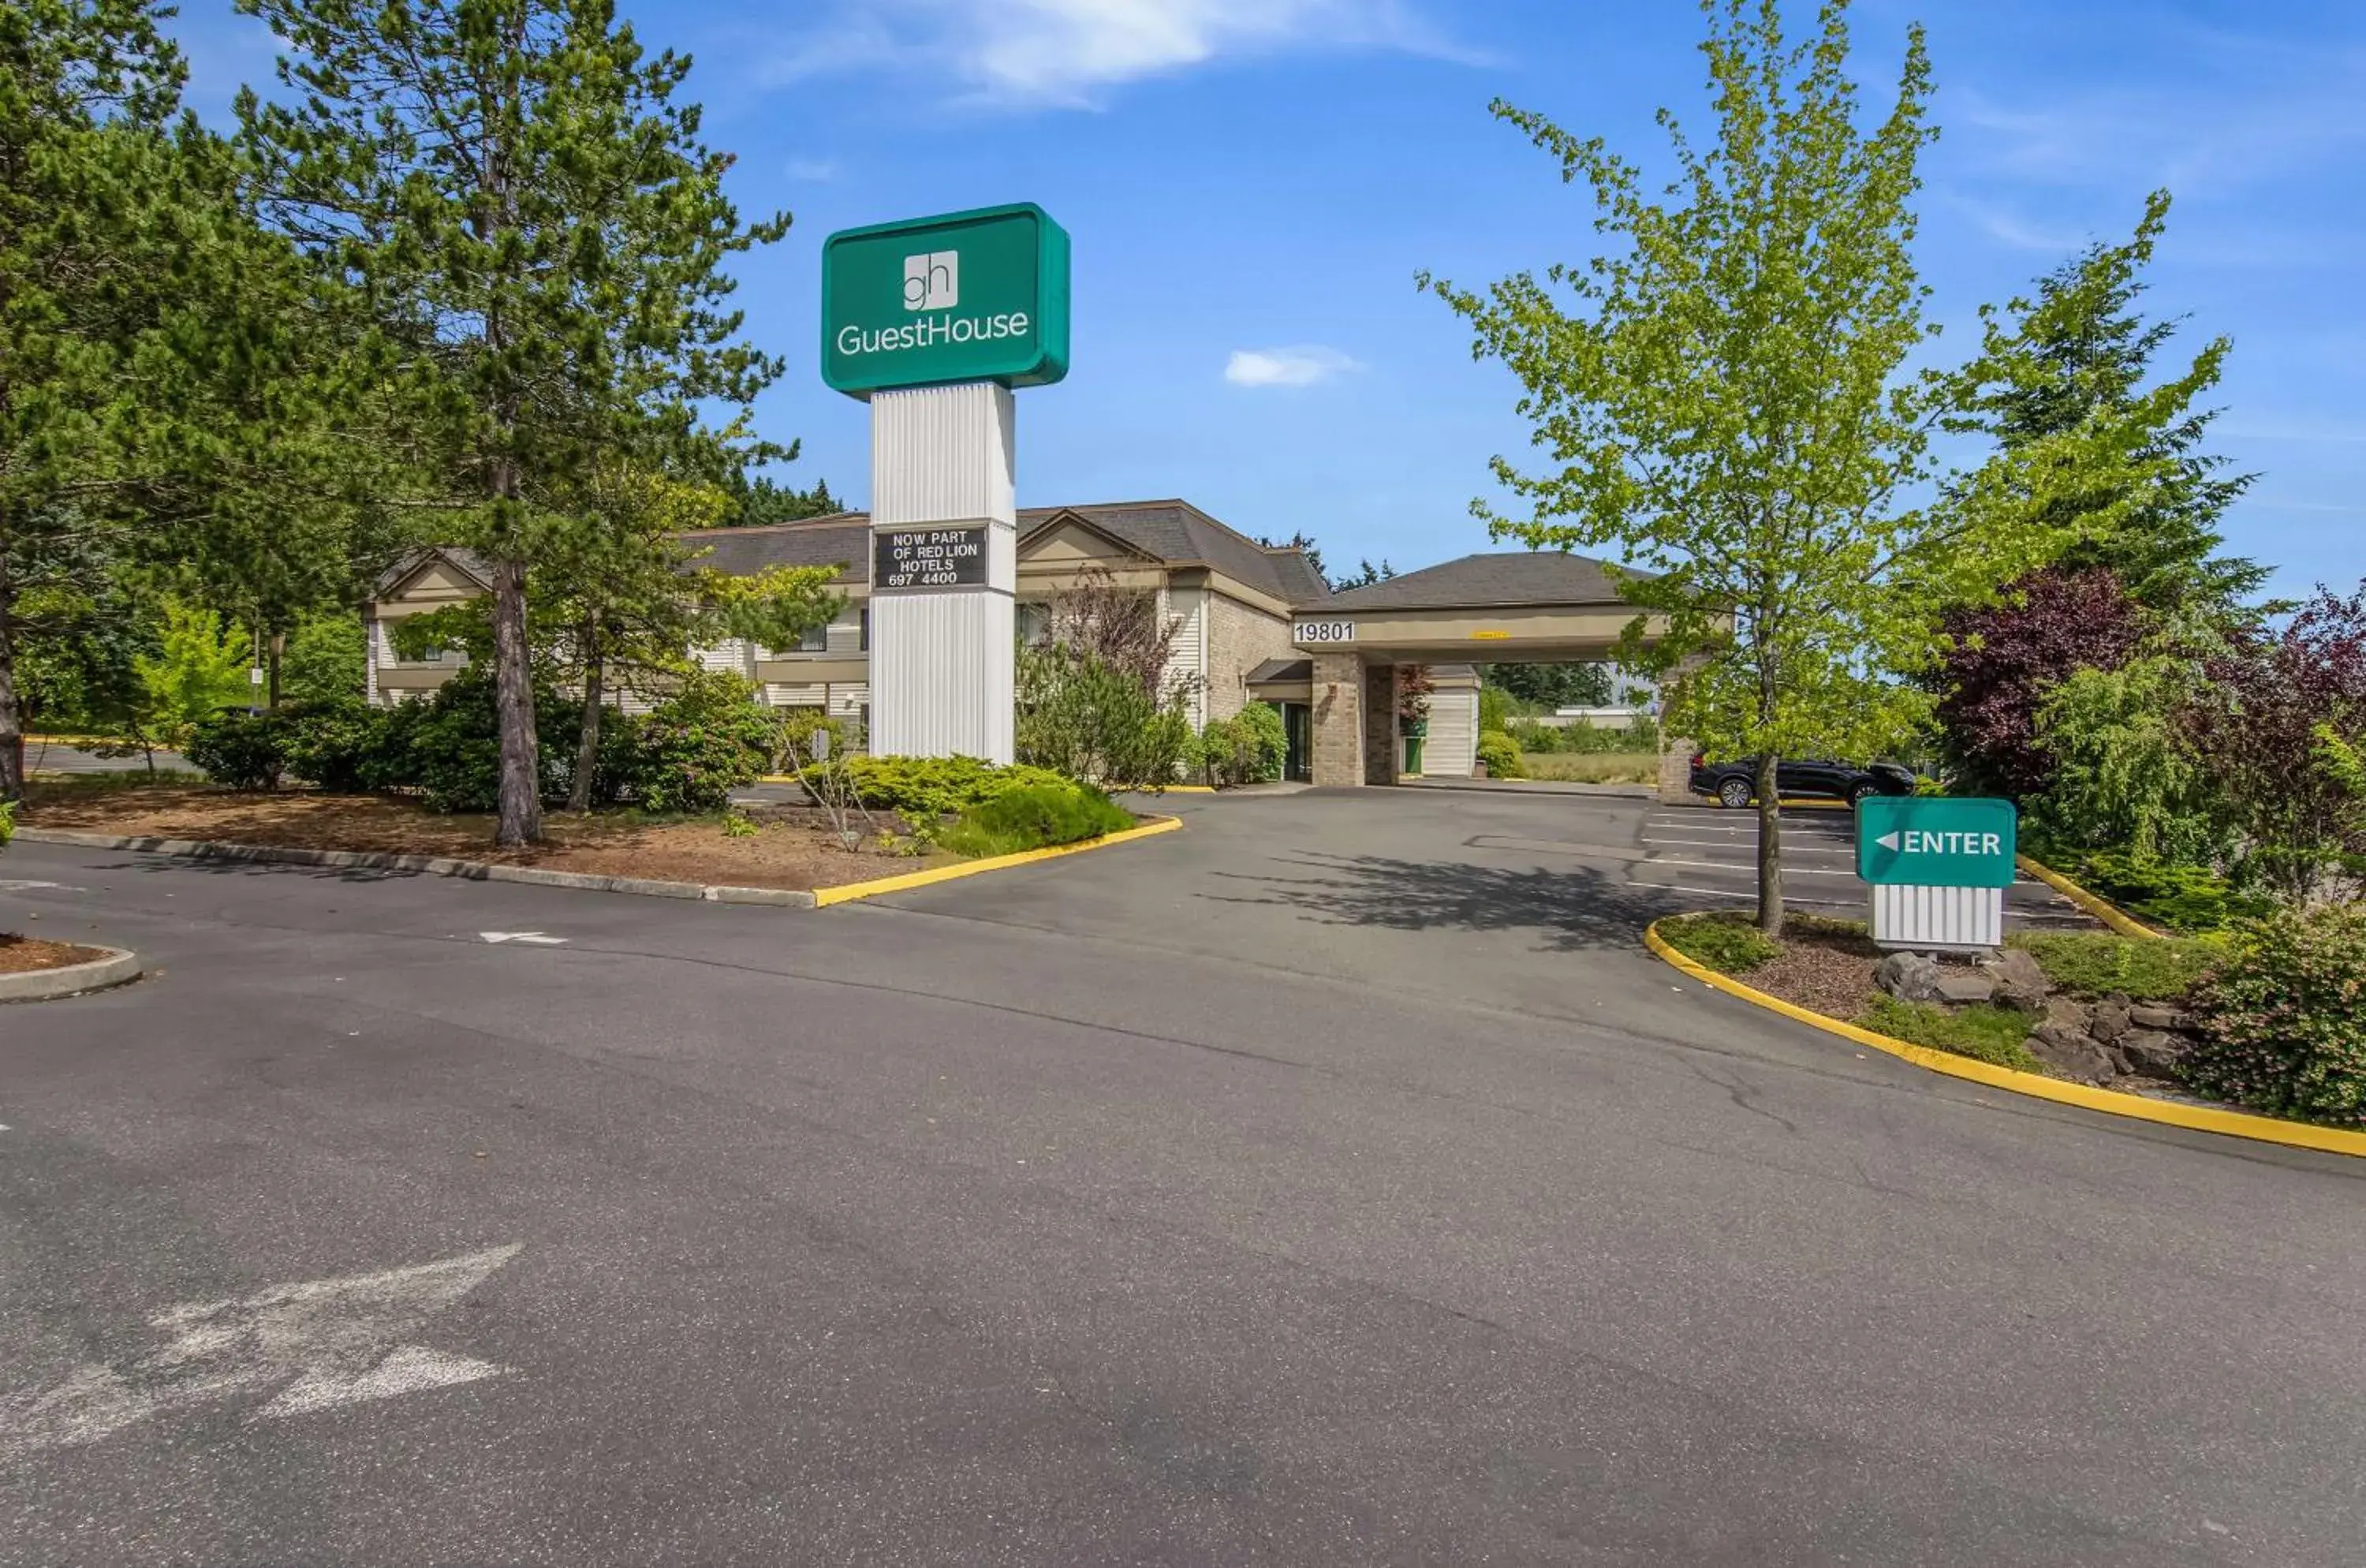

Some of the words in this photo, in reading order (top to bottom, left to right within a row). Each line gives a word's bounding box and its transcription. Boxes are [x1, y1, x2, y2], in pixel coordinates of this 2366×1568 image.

[837, 312, 1028, 356] GuestHouse
[894, 532, 926, 546] NOW
[931, 531, 967, 544] PART
[894, 547, 912, 559] OF
[917, 546, 944, 559] RED
[946, 544, 977, 557] LION
[900, 558, 953, 572] HOTELS
[889, 573, 913, 586] 697
[922, 572, 957, 584] 4400
[1296, 622, 1353, 640] 19801
[1905, 831, 2001, 855] ENTER
